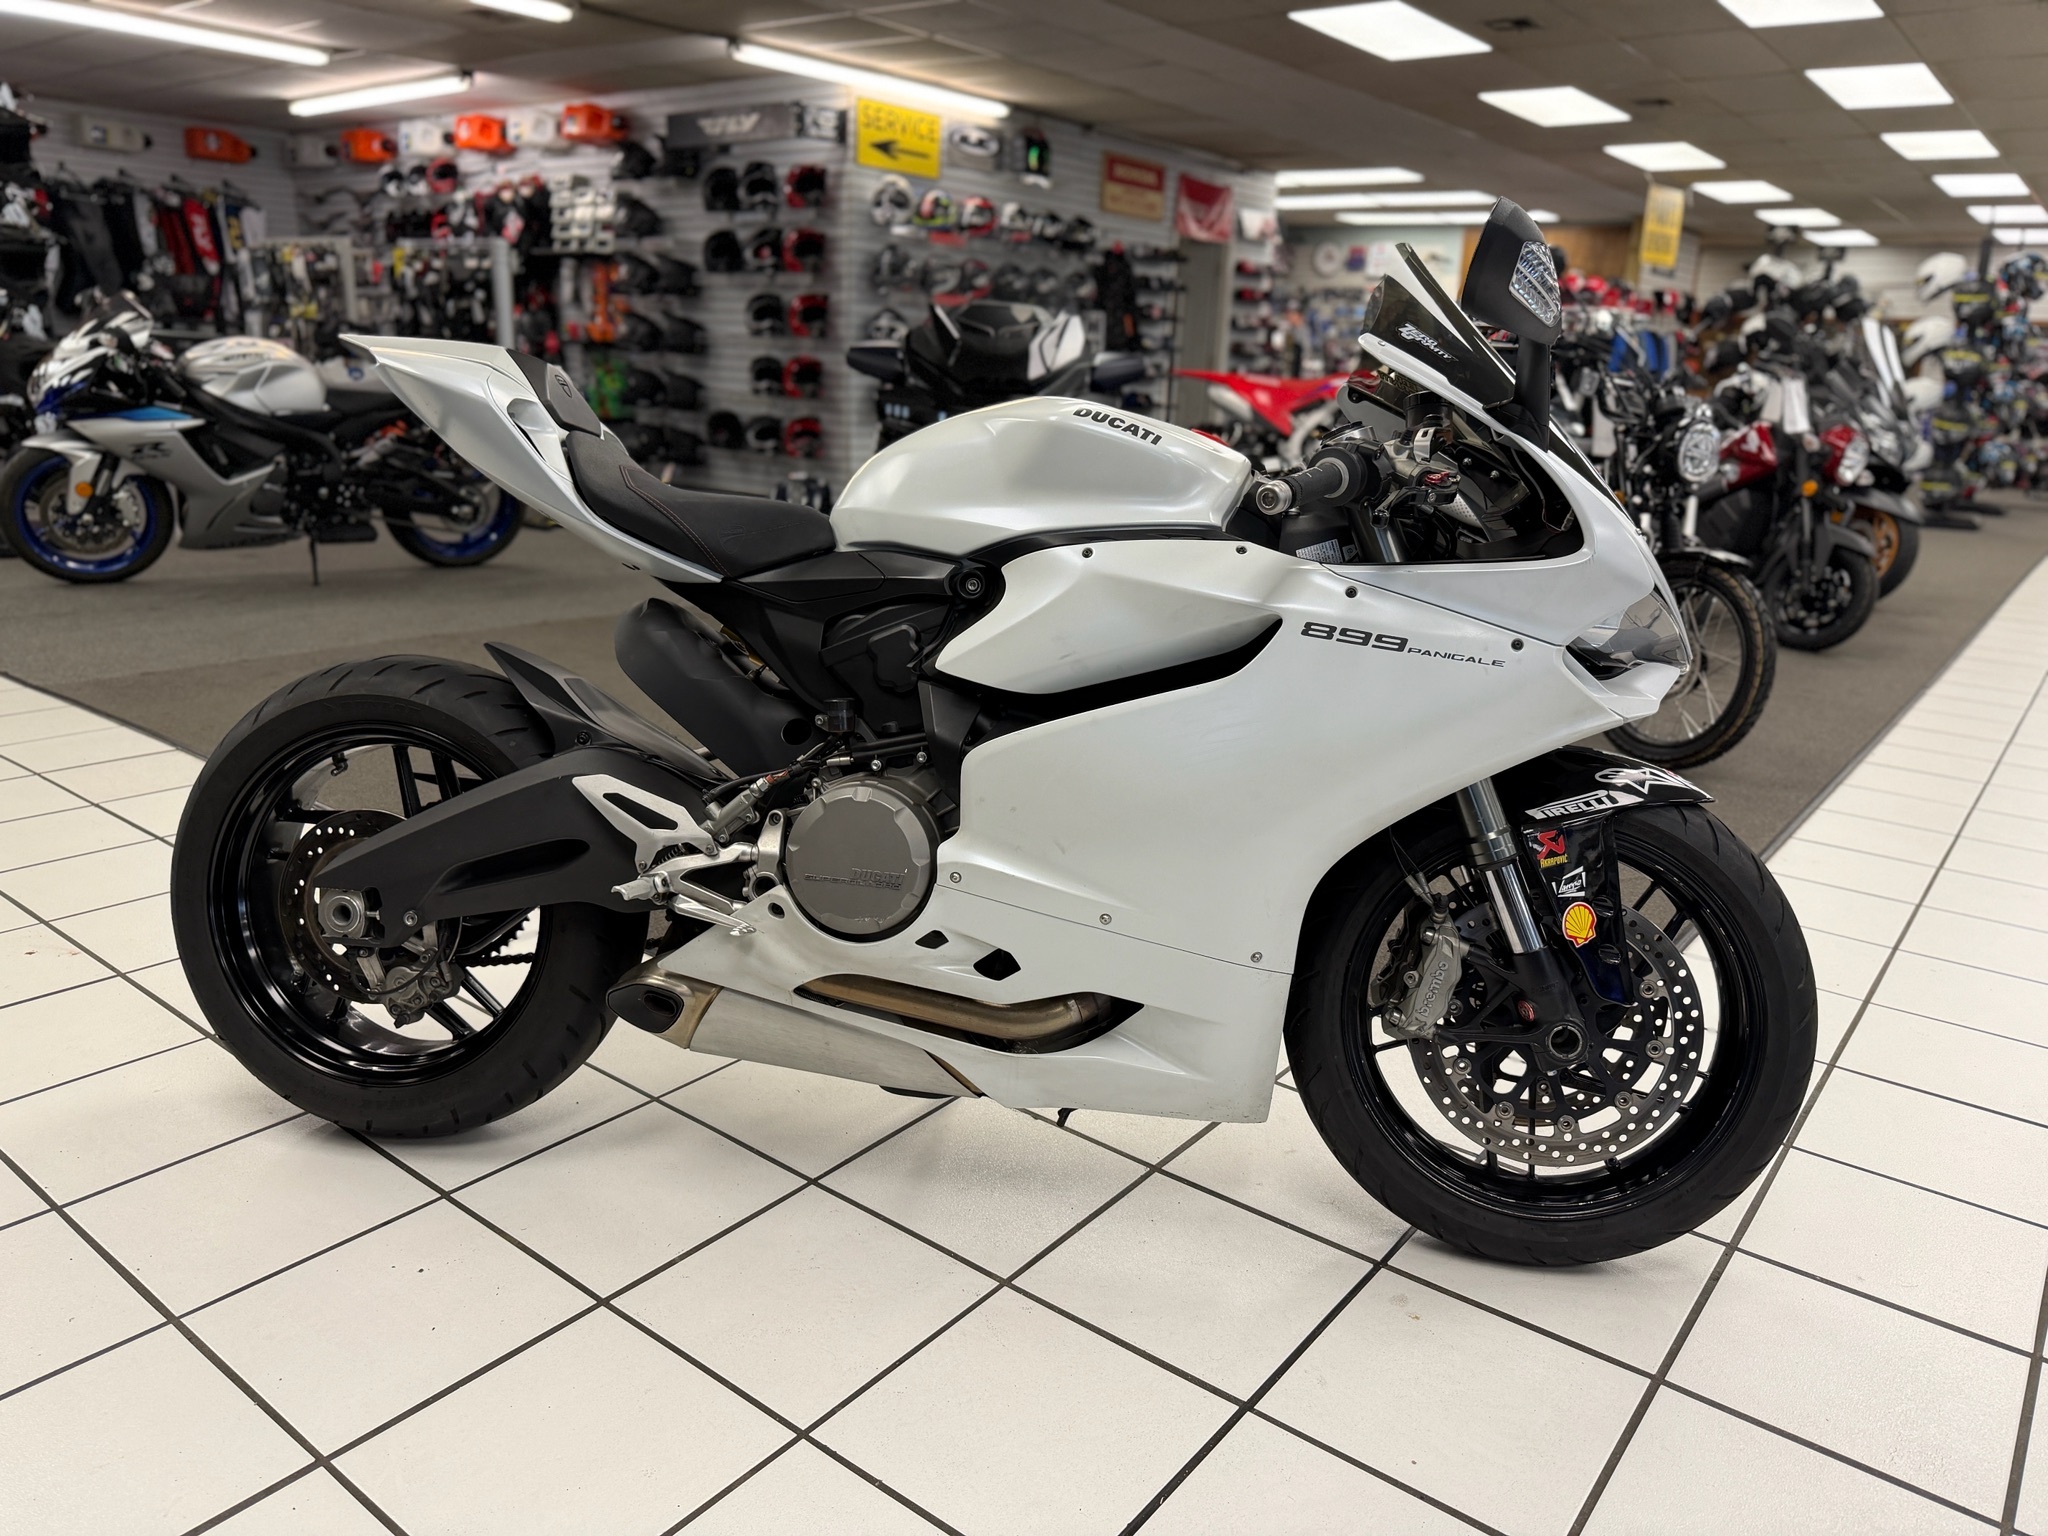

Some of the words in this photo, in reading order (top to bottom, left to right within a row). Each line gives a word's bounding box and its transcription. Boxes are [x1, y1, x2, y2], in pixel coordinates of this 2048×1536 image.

[861, 104, 937, 143] SERVICE
[1398, 322, 1437, 345] ZERO
[1401, 331, 1452, 359] GRAVITY
[1073, 408, 1163, 446] DUCATI
[1300, 621, 1409, 653] 899
[1407, 647, 1506, 668] PANIGALE
[1525, 790, 1616, 820] PIRELLI
[851, 867, 904, 884] DUCATI
[1416, 960, 1449, 1018] brembo
